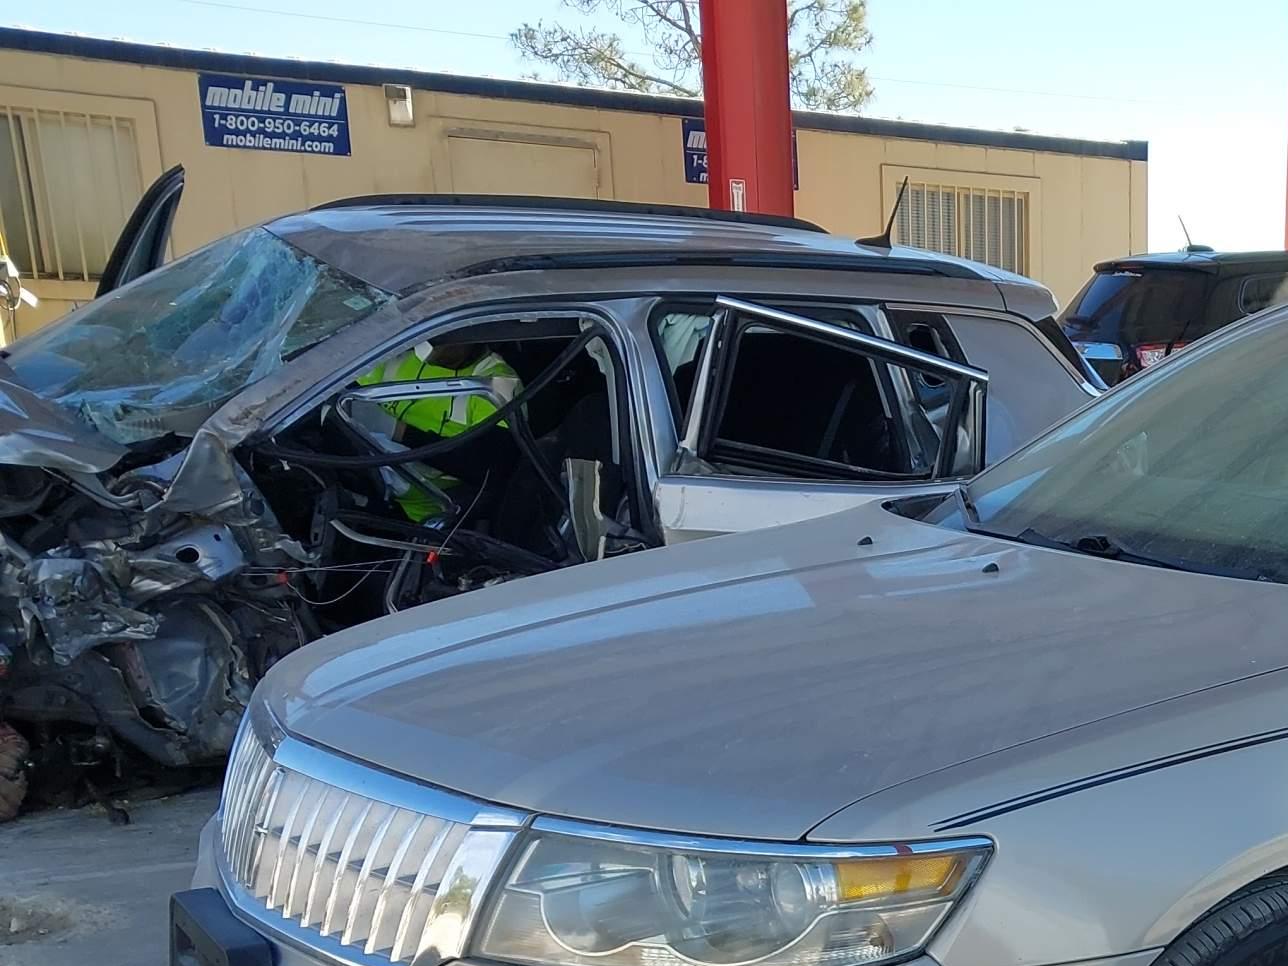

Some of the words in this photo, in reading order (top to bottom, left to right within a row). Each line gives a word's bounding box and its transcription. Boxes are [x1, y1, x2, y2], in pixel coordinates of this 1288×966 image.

[205, 80, 286, 113] mobile
[288, 91, 341, 117] mini
[213, 114, 339, 138] 1-800-950-6464
[223, 133, 334, 153] mobilemini.com
